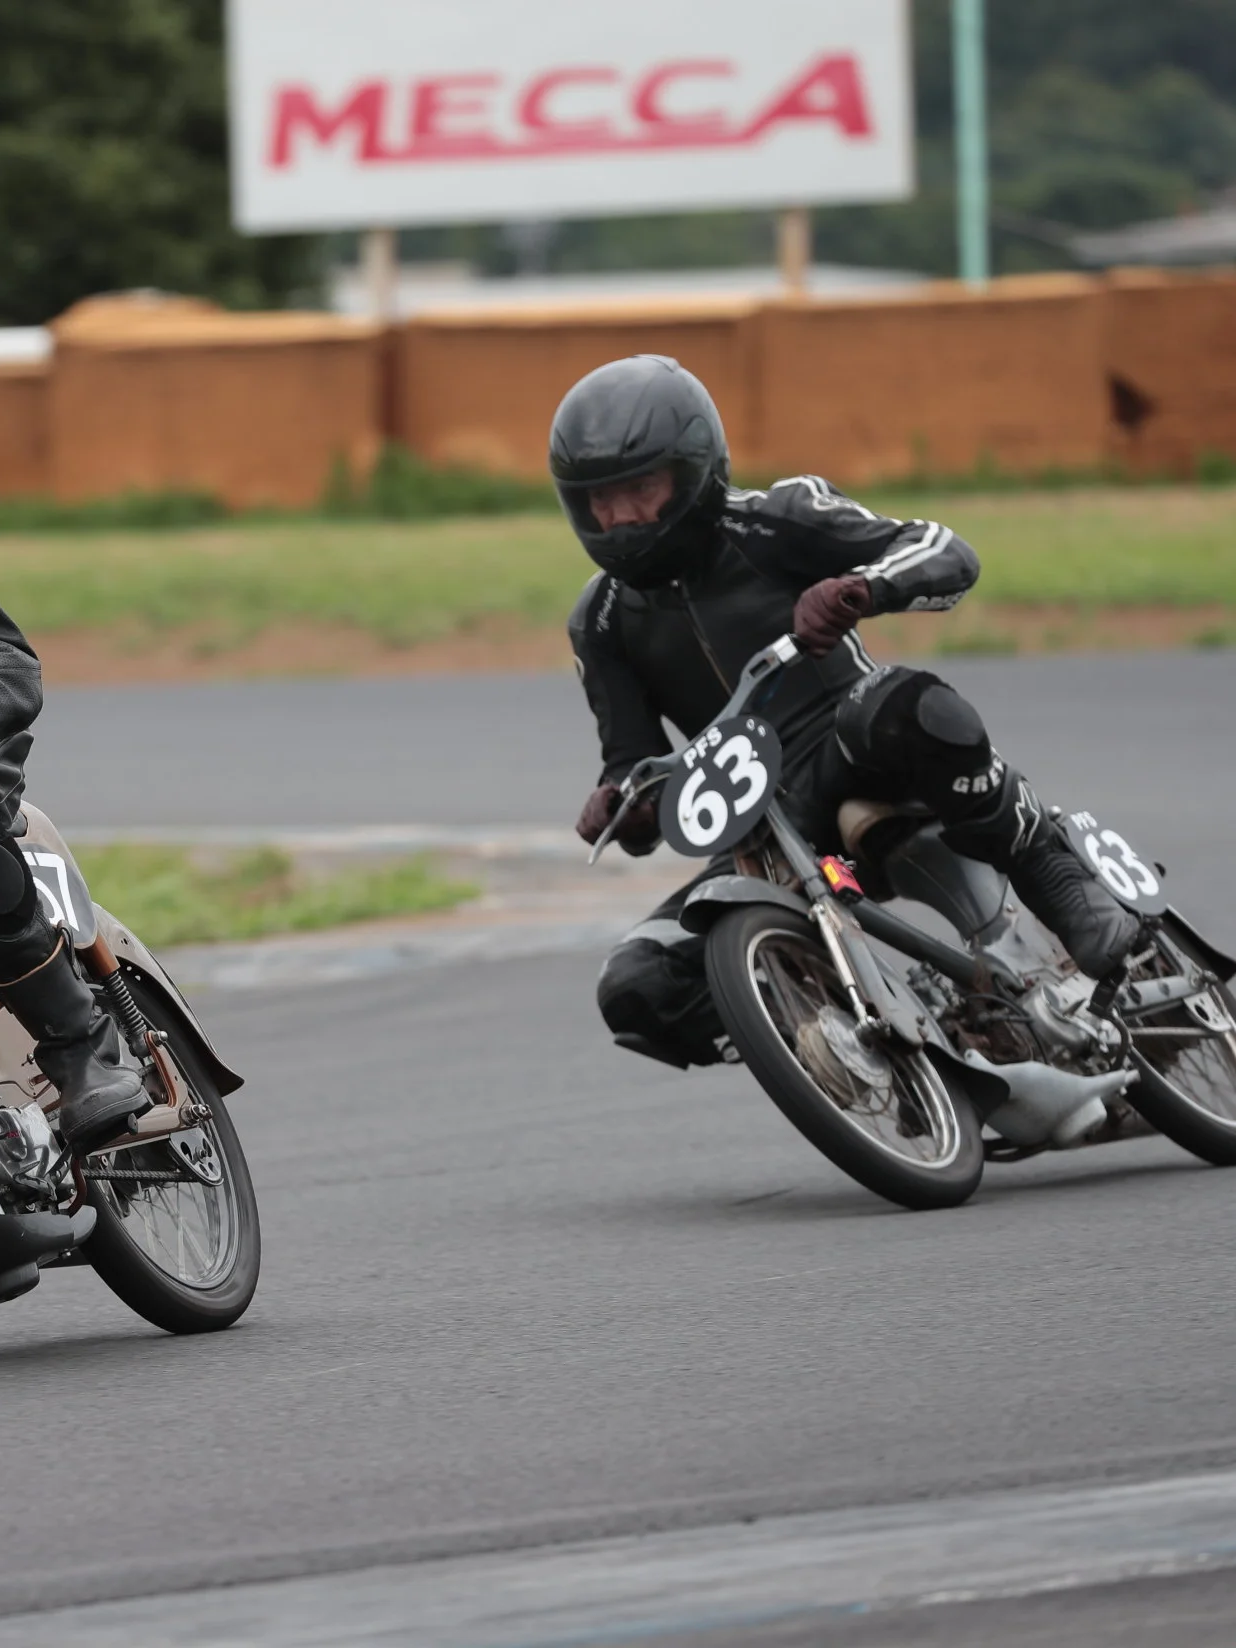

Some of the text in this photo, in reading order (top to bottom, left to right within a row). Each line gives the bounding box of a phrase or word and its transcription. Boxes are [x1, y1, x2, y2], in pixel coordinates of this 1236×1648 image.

[268, 49, 874, 170] MECCA
[682, 726, 723, 770] PFS
[677, 734, 768, 847] 63
[1070, 811, 1097, 831] PFS
[1085, 830, 1159, 900] 63
